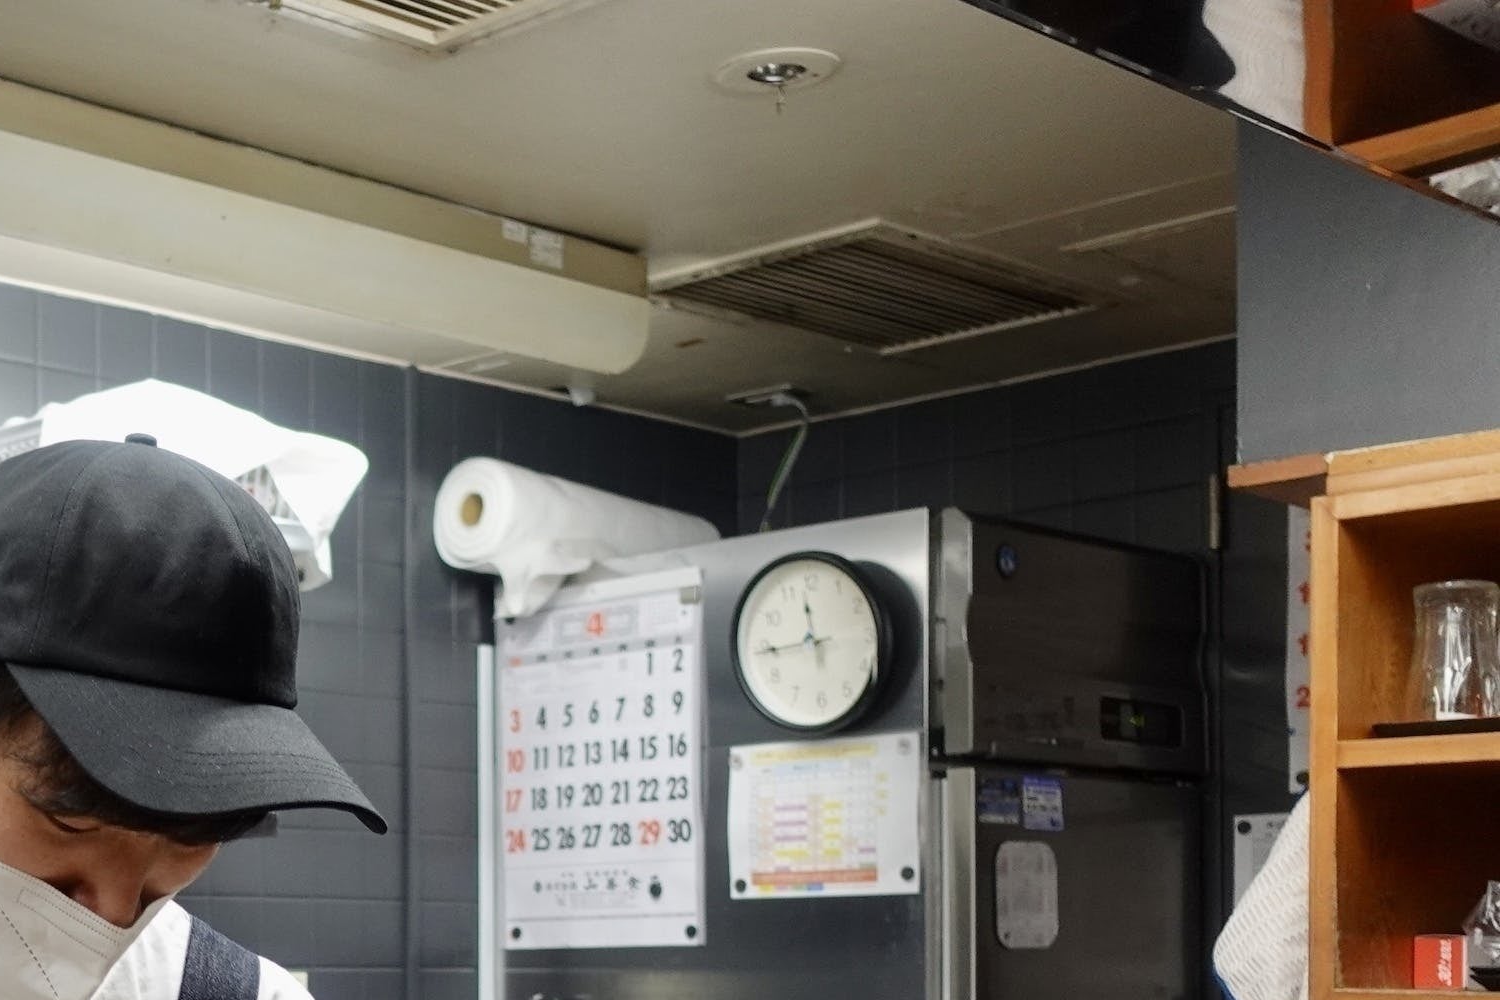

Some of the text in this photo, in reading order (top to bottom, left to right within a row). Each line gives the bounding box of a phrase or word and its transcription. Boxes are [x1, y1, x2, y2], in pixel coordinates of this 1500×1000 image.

[781, 586, 796, 601] 11
[803, 572, 819, 591] 12
[584, 611, 607, 637] 4
[764, 609, 781, 627] 10
[672, 647, 684, 673] 2
[816, 692, 828, 708] 6
[843, 681, 854, 699] 5
[510, 690, 684, 734] 3 4 5 6 7 8 9
[506, 733, 688, 774] 10 11 12 13 14 15 16
[505, 775, 689, 814] 17 18 19 20 21 22 23
[505, 817, 692, 854] 24 25 26 27 28 29 30
